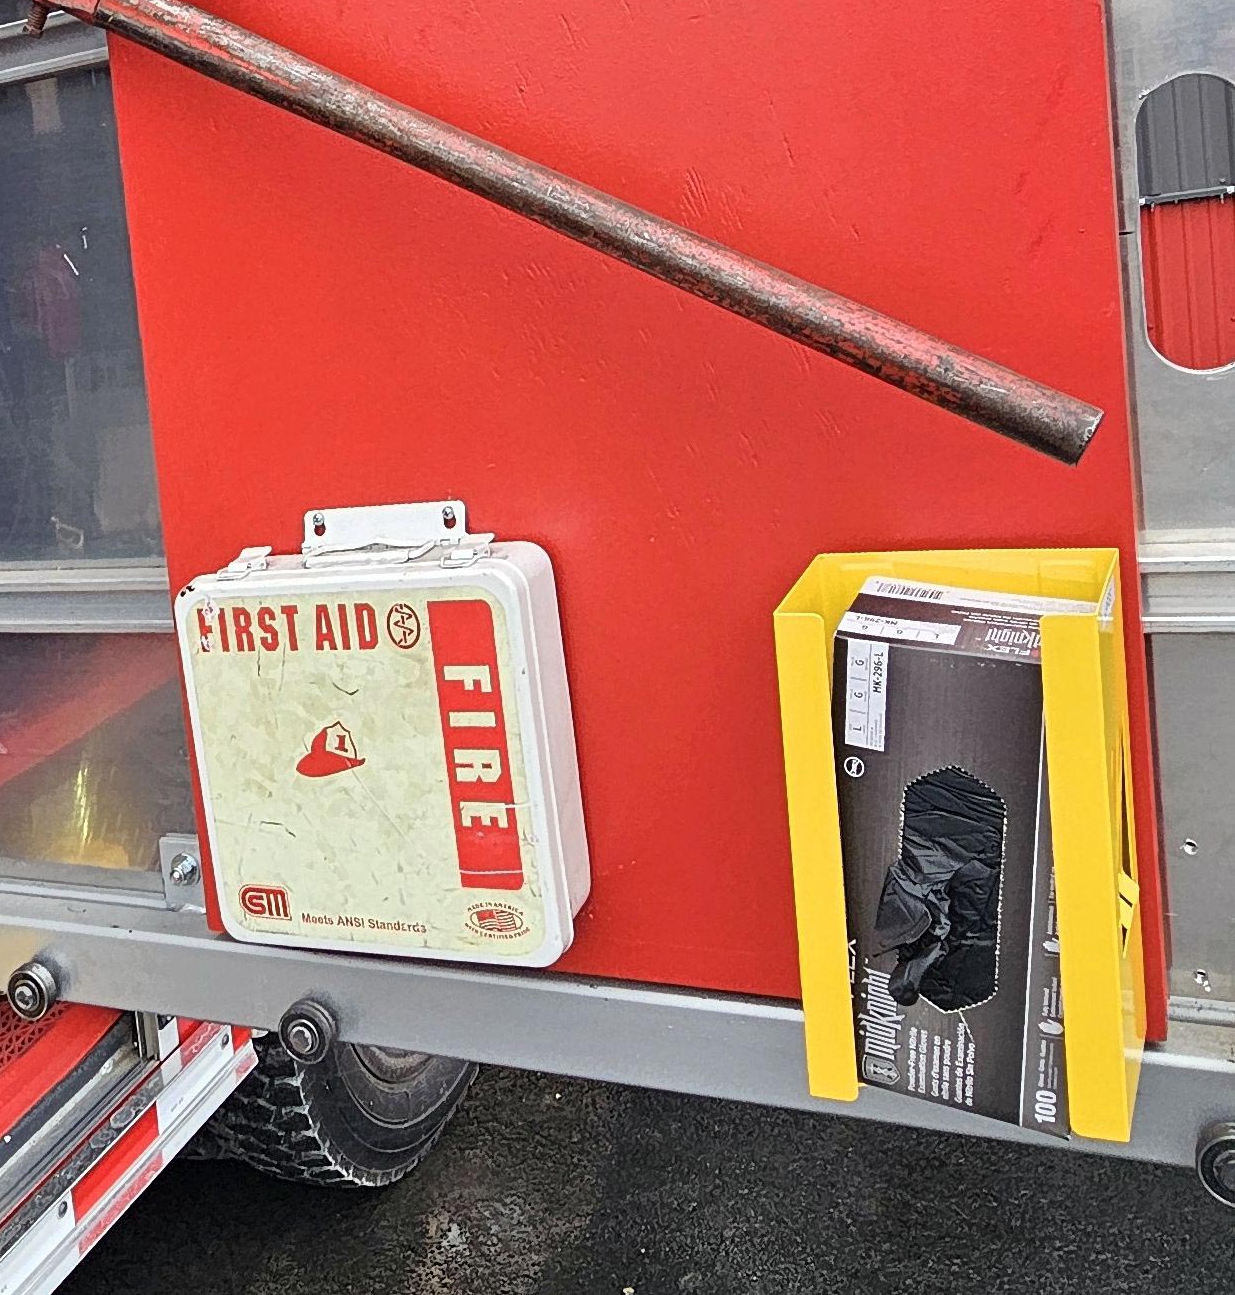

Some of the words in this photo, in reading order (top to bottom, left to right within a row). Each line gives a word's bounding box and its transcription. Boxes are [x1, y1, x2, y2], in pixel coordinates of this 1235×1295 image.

[196, 605, 299, 652] FIRST
[316, 603, 379, 650] AID
[985, 628, 1041, 649] dknight
[872, 652, 884, 693] MK-296-L
[334, 734, 349, 753] 1
[443, 665, 509, 828] FIRE
[302, 913, 334, 925] Meets
[337, 916, 365, 928] ANSI
[368, 919, 427, 933] Standards
[1035, 1090, 1057, 1123] 100
